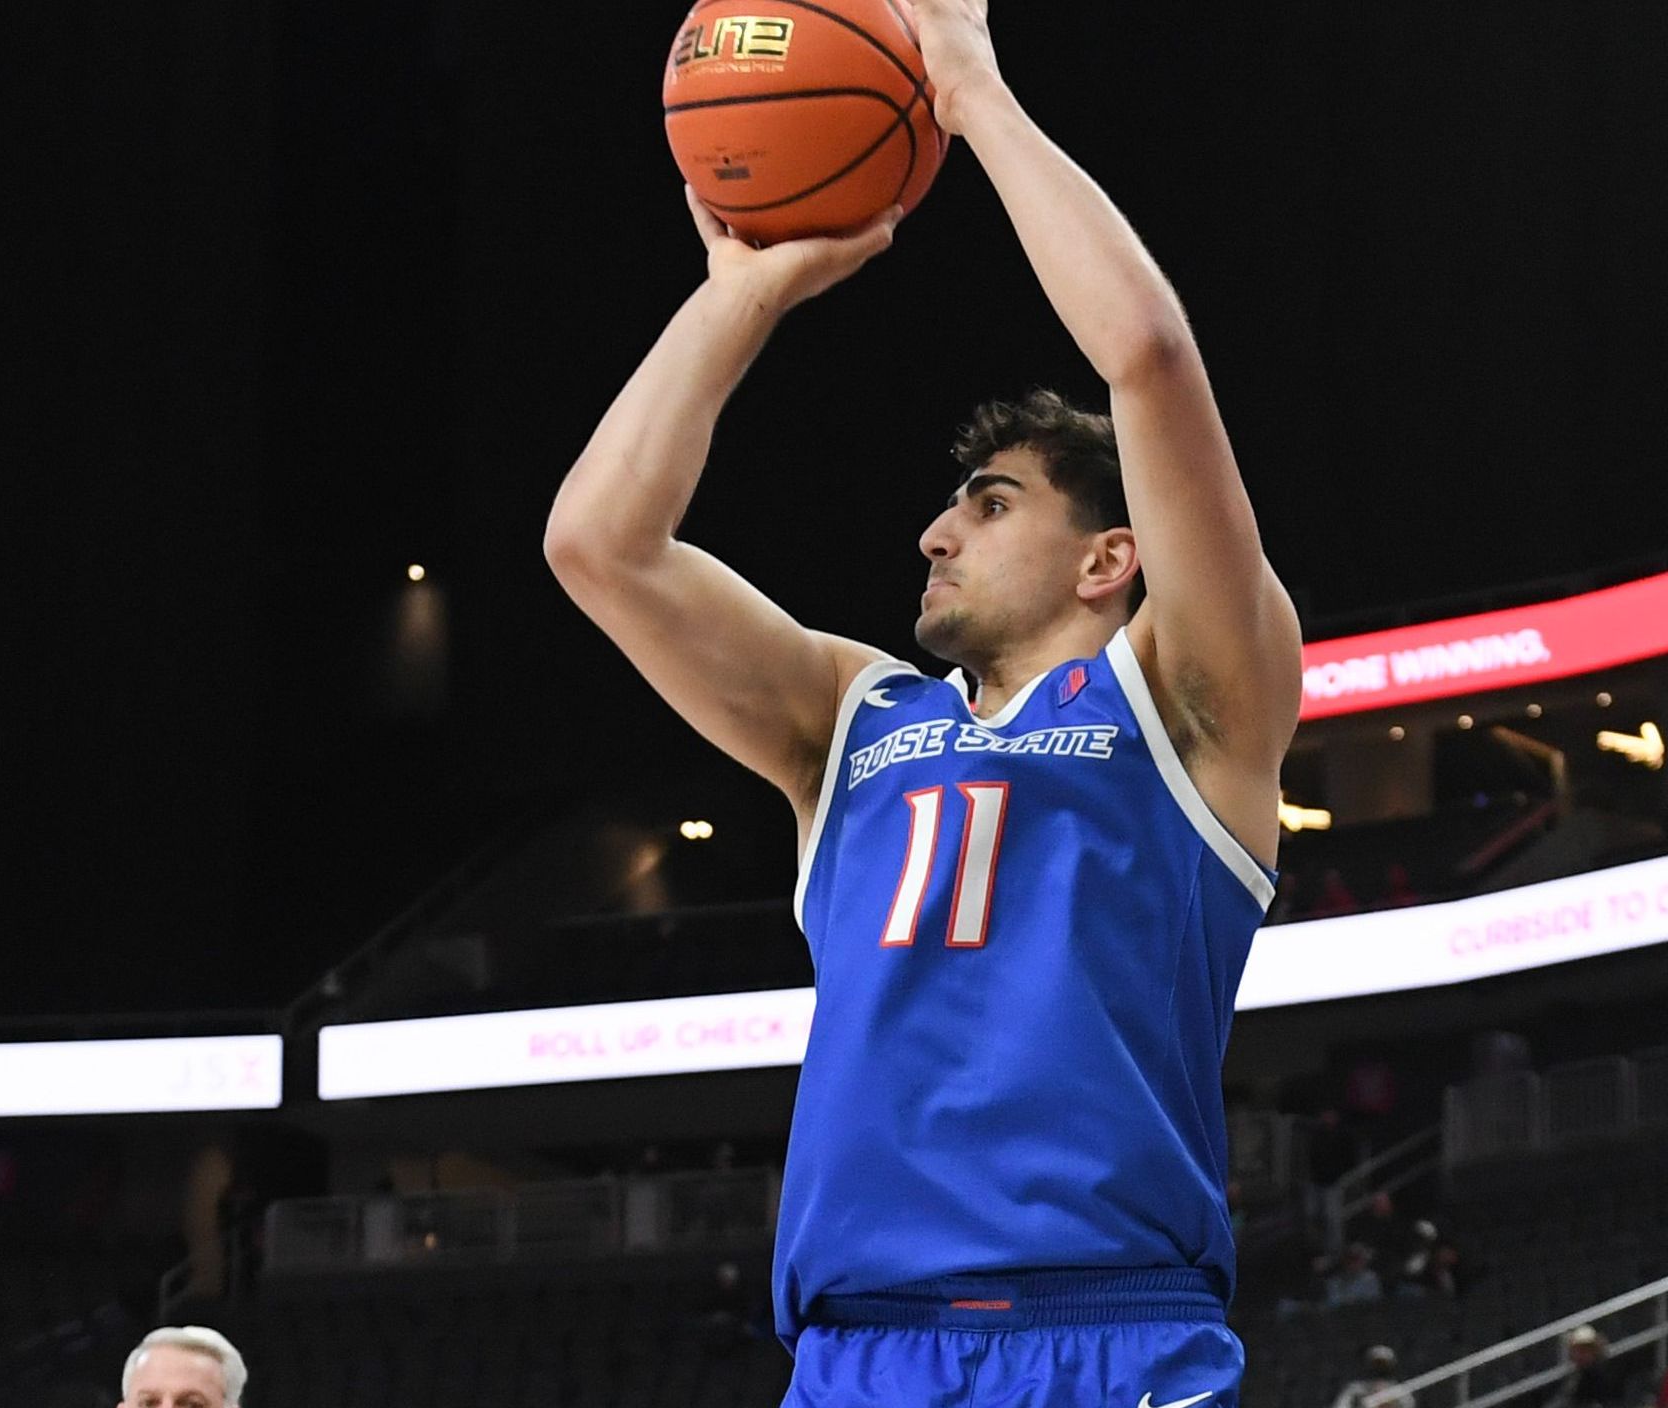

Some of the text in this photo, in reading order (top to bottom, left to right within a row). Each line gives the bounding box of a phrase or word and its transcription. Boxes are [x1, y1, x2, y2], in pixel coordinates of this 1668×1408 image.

[847, 718, 957, 791] BOISE
[879, 780, 1011, 950] 11
[1448, 899, 1594, 957] CURBSIDE
[1607, 892, 1646, 924] TO
[528, 1031, 606, 1058] ROLL
